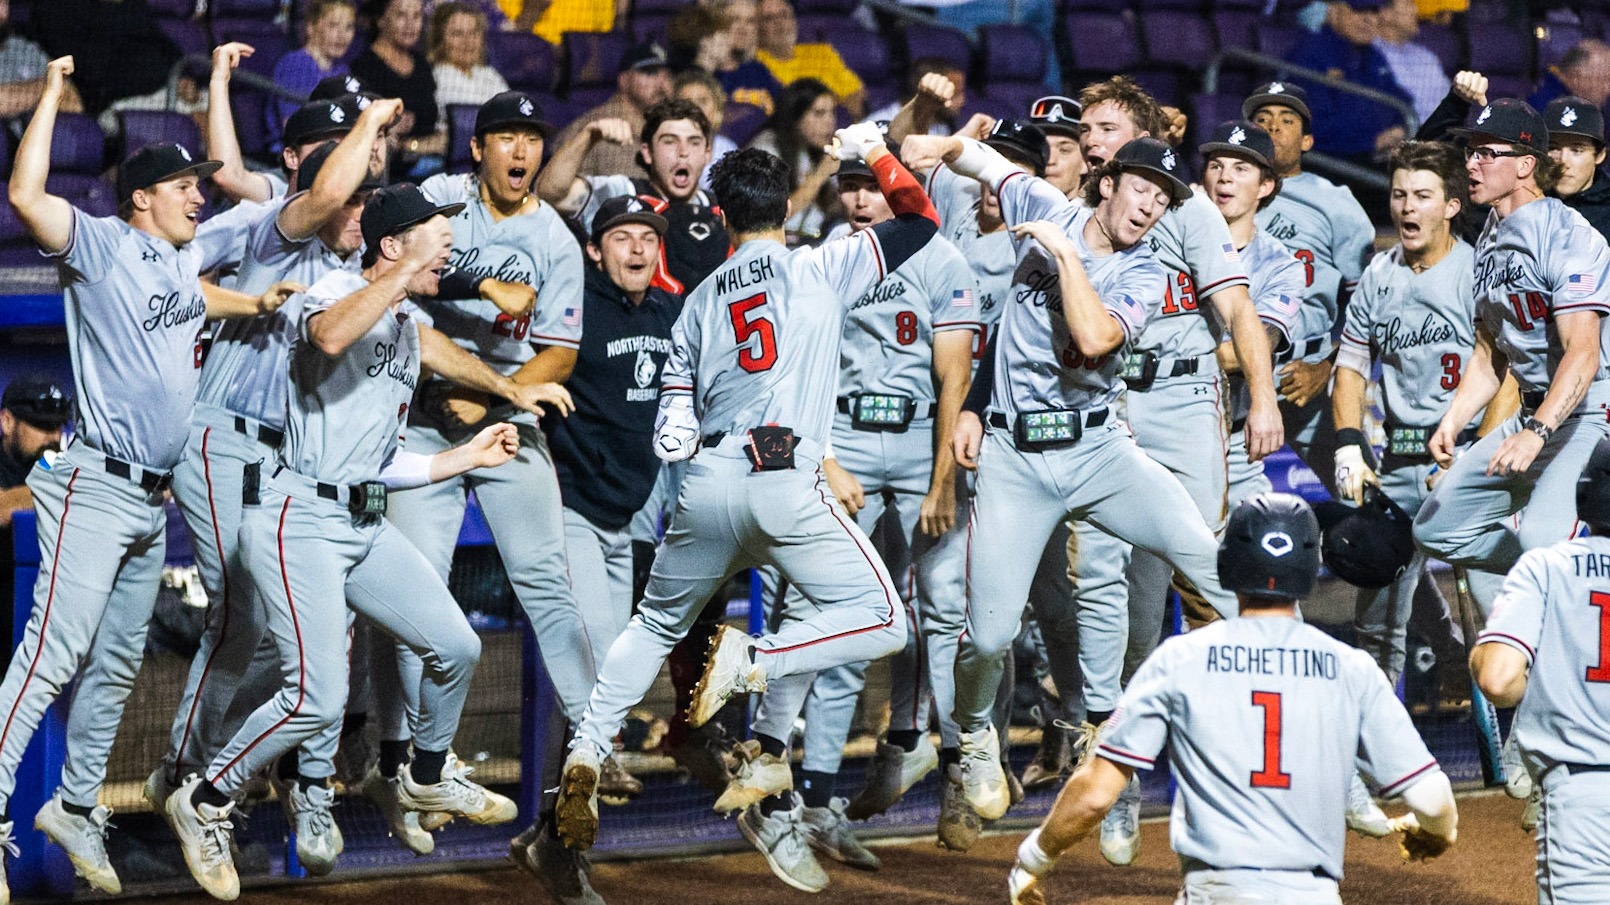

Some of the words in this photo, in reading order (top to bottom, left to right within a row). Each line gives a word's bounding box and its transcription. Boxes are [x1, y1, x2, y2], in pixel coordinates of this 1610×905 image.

[716, 255, 775, 296] WALSH
[850, 277, 908, 311] uskies
[1162, 270, 1199, 315] 13
[143, 291, 207, 332] Huskies
[895, 310, 918, 346] 8
[1507, 290, 1550, 334] 14
[606, 335, 673, 358] NORTHEASTER
[728, 291, 779, 375] 5
[1374, 312, 1454, 355] Huskies
[1440, 352, 1462, 392] 3
[1207, 645, 1337, 681] ASCHETTINO
[1250, 690, 1292, 790] 1
